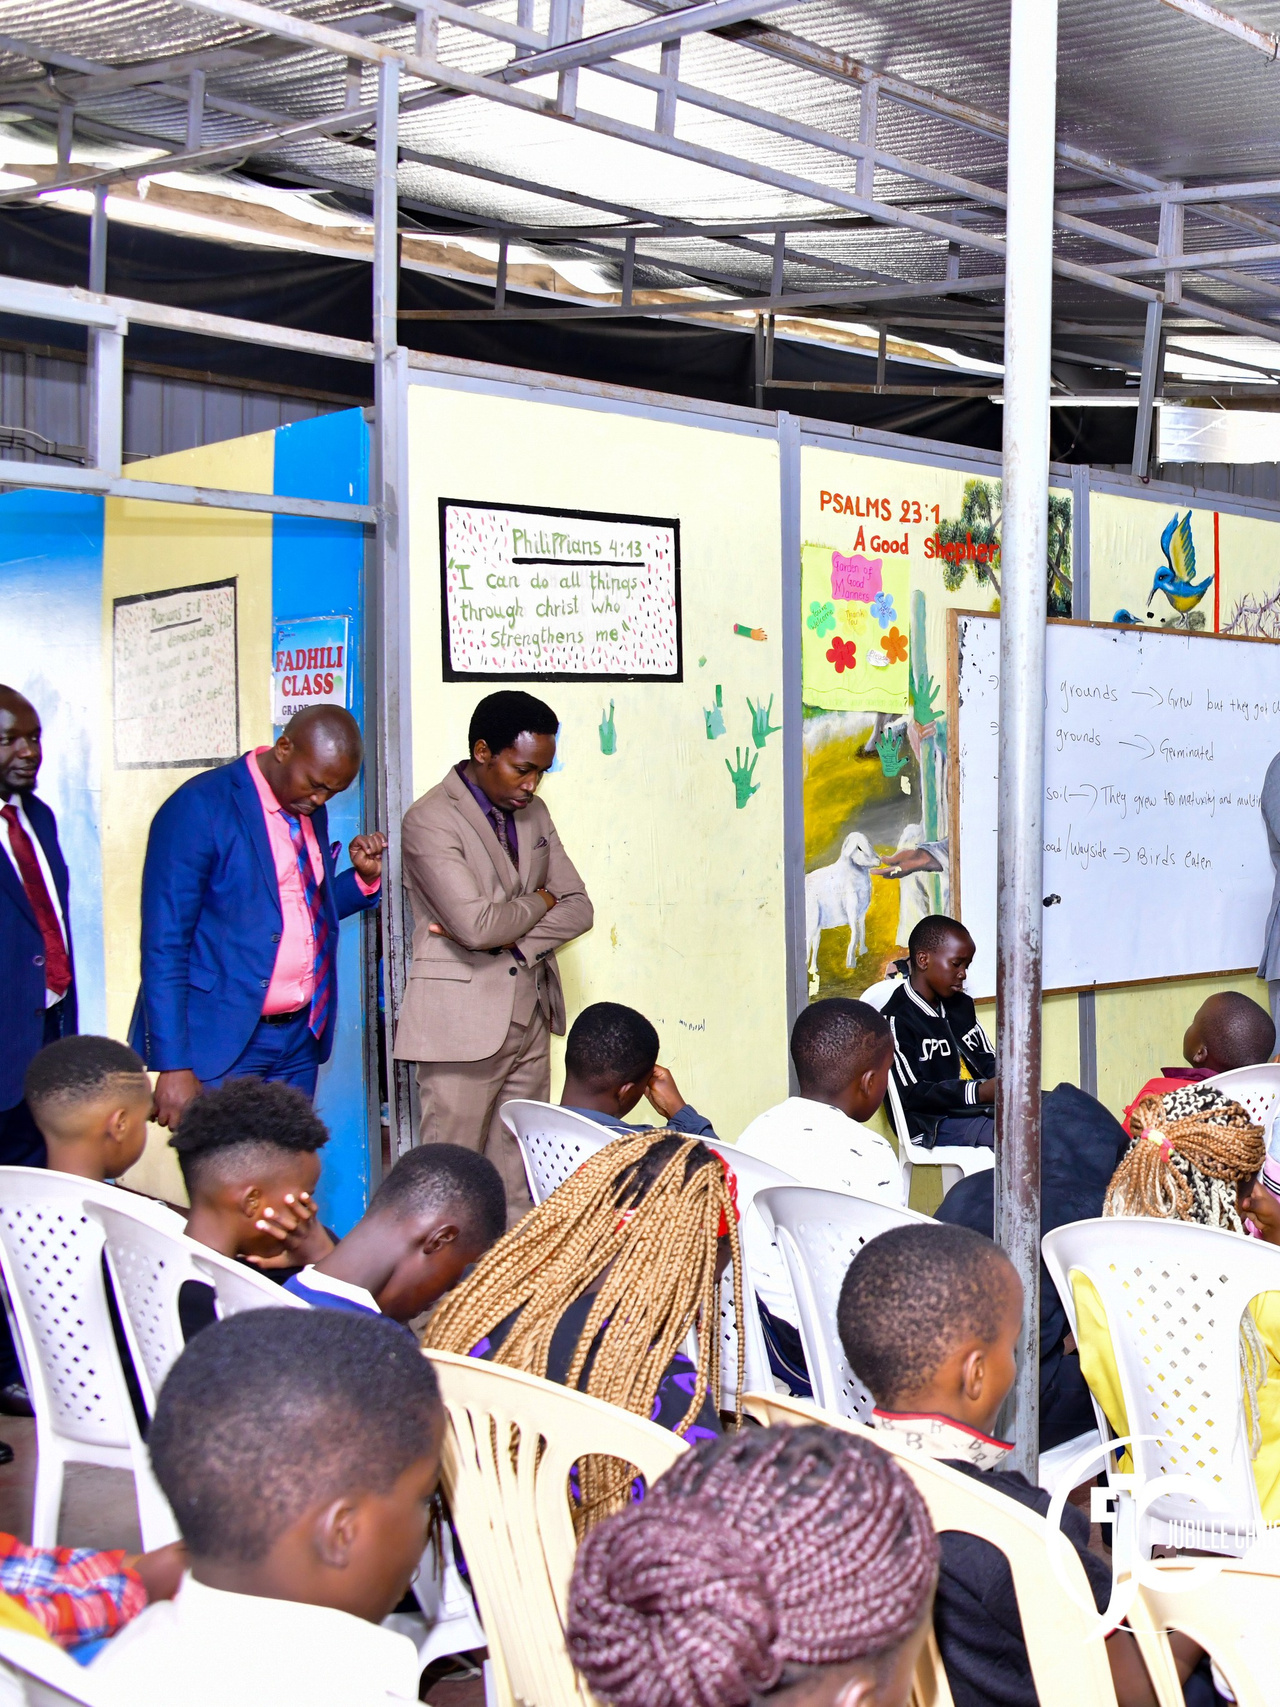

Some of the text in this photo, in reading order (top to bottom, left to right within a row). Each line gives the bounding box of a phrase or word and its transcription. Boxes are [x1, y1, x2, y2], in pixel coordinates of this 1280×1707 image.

[820, 490, 940, 526] PSALMS 23:1
[609, 539, 642, 558] 4:13
[853, 525, 1003, 567] A Good Shepher
[486, 572, 520, 590] can
[530, 571, 549, 589] do
[559, 570, 581, 589] all
[589, 570, 638, 599] things
[847, 574, 865, 589] Good
[863, 566, 873, 581] of
[834, 579, 870, 601] Manners
[460, 599, 524, 629] through
[592, 597, 620, 614] who
[490, 627, 584, 658] strengthens
[275, 646, 343, 672] FADHILI
[282, 672, 334, 697] CLASS
[1059, 680, 1118, 714] grounds
[1206, 689, 1223, 711] but
[1229, 700, 1249, 721] they
[1056, 727, 1214, 764] grounds Germinated
[1101, 785, 1127, 820] They
[1134, 795, 1157, 814] grew
[1219, 793, 1232, 806] and
[1137, 845, 1176, 867] Birds
